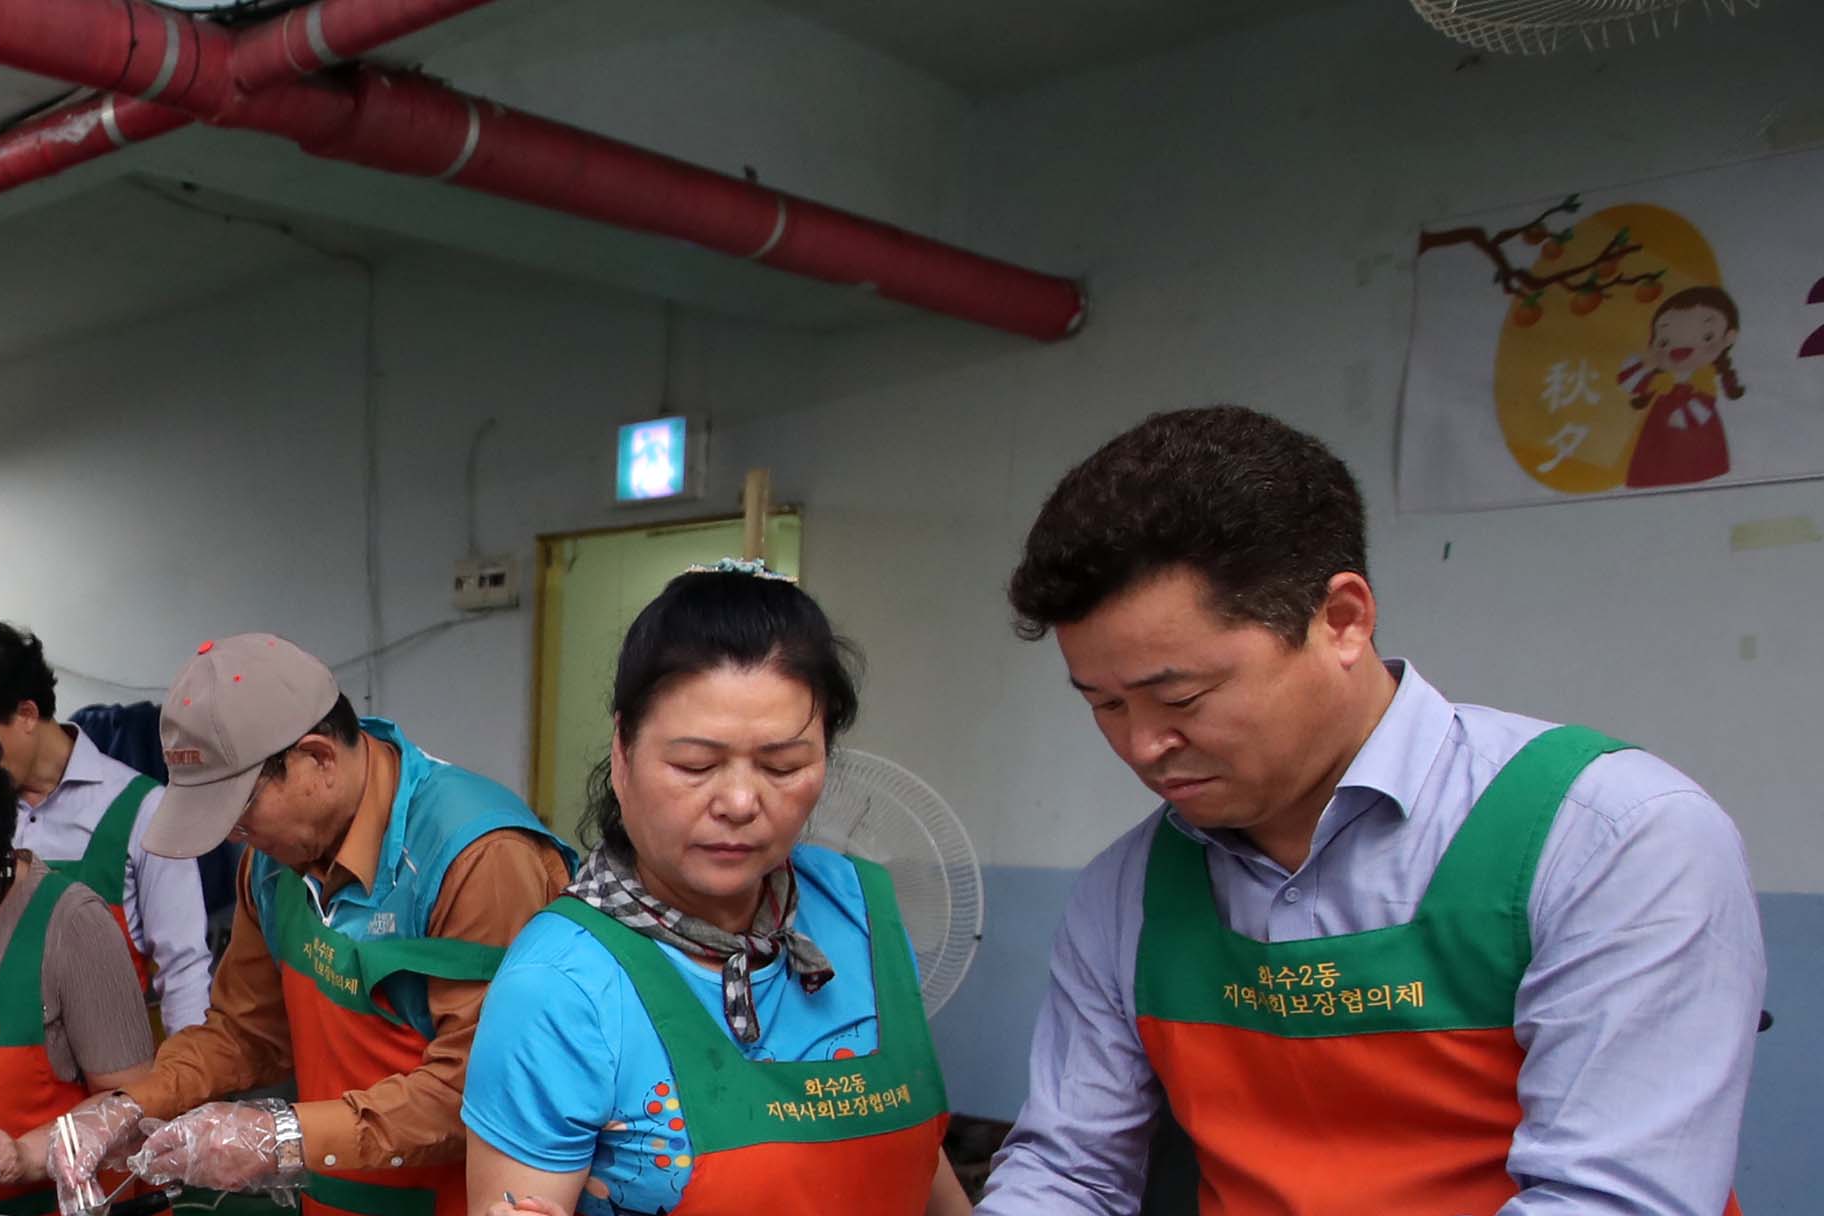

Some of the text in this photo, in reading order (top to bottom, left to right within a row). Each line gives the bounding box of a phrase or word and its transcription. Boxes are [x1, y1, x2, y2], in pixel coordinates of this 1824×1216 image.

[1258, 961, 1342, 988] 화수2동
[803, 1072, 867, 1099] 화수2동
[765, 1083, 912, 1121] 지역사회보장협의체
